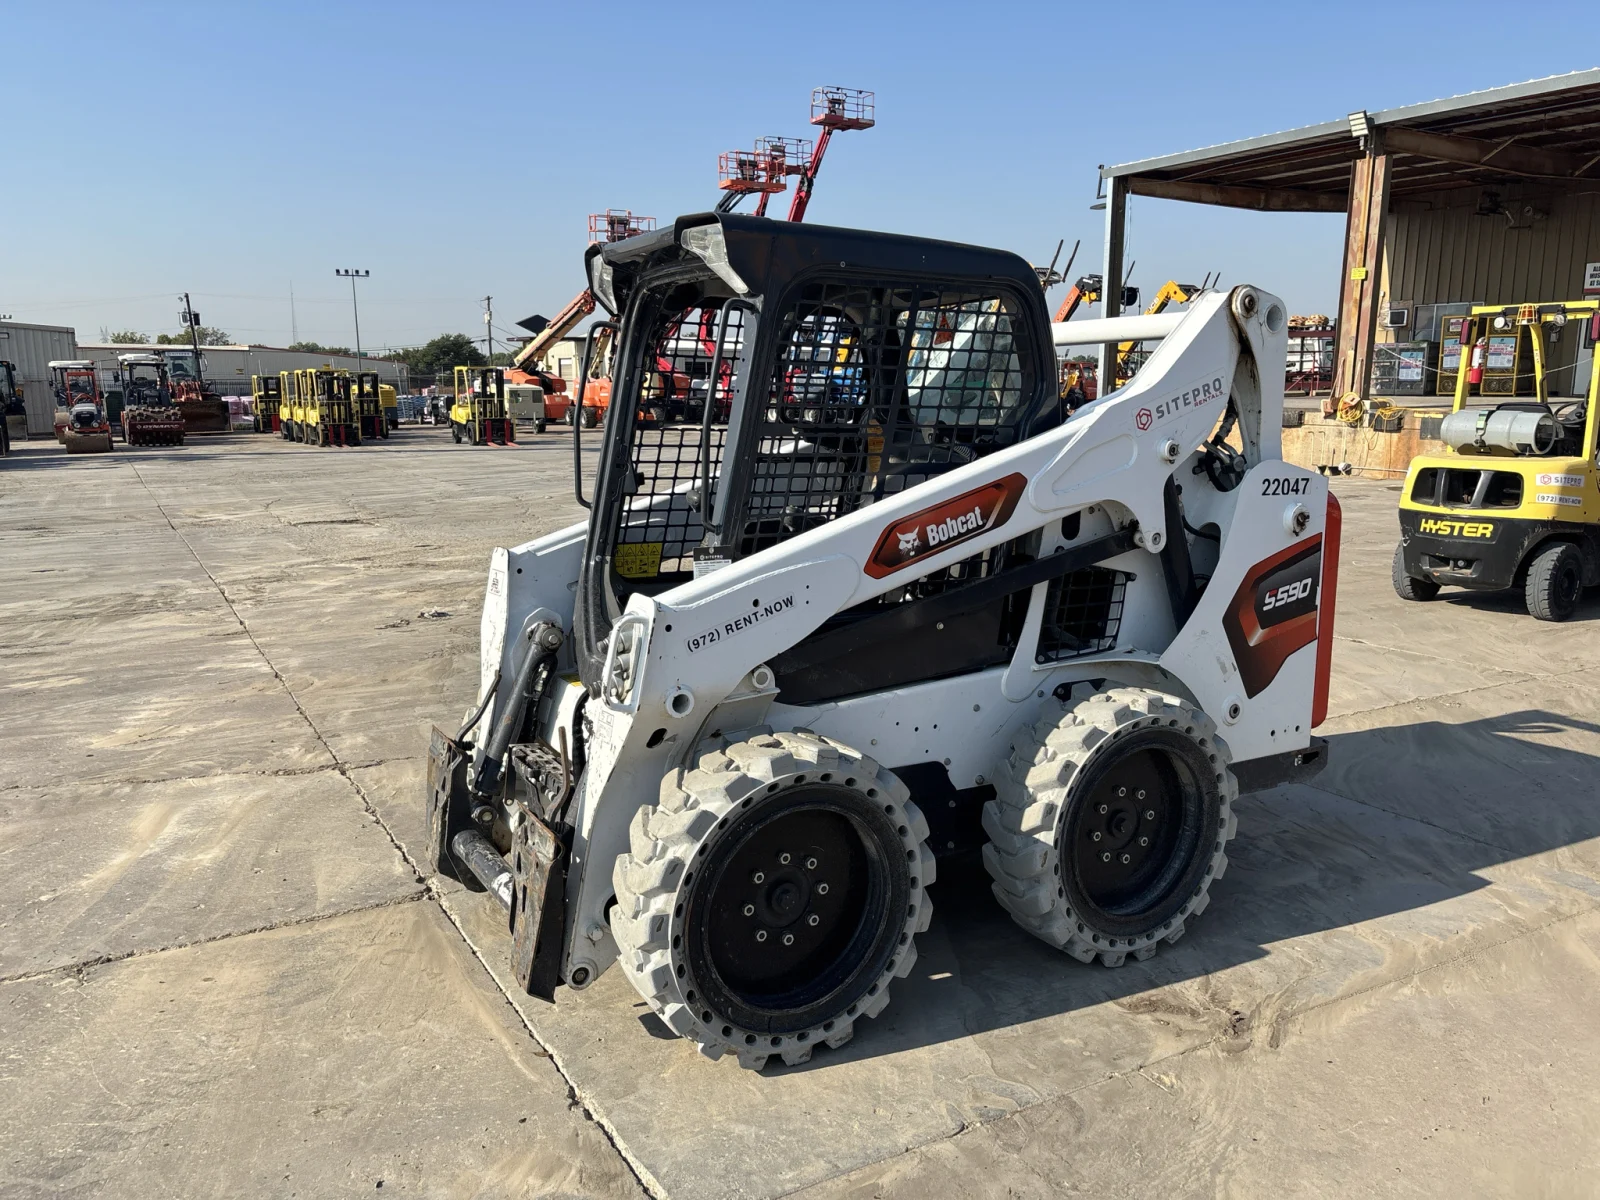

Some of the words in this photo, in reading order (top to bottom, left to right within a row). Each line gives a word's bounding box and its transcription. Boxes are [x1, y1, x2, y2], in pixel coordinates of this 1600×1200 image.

[1155, 377, 1222, 420] SITEPRO
[1194, 389, 1224, 407] RENTALS
[1261, 477, 1310, 496] 22047
[1554, 476, 1582, 485] SITEPRO
[926, 506, 983, 547] Bobcat
[1420, 518, 1494, 538] HYSTER
[1262, 577, 1312, 612] S590
[687, 628, 721, 653] (972)
[724, 595, 794, 635] RENT-NOW
